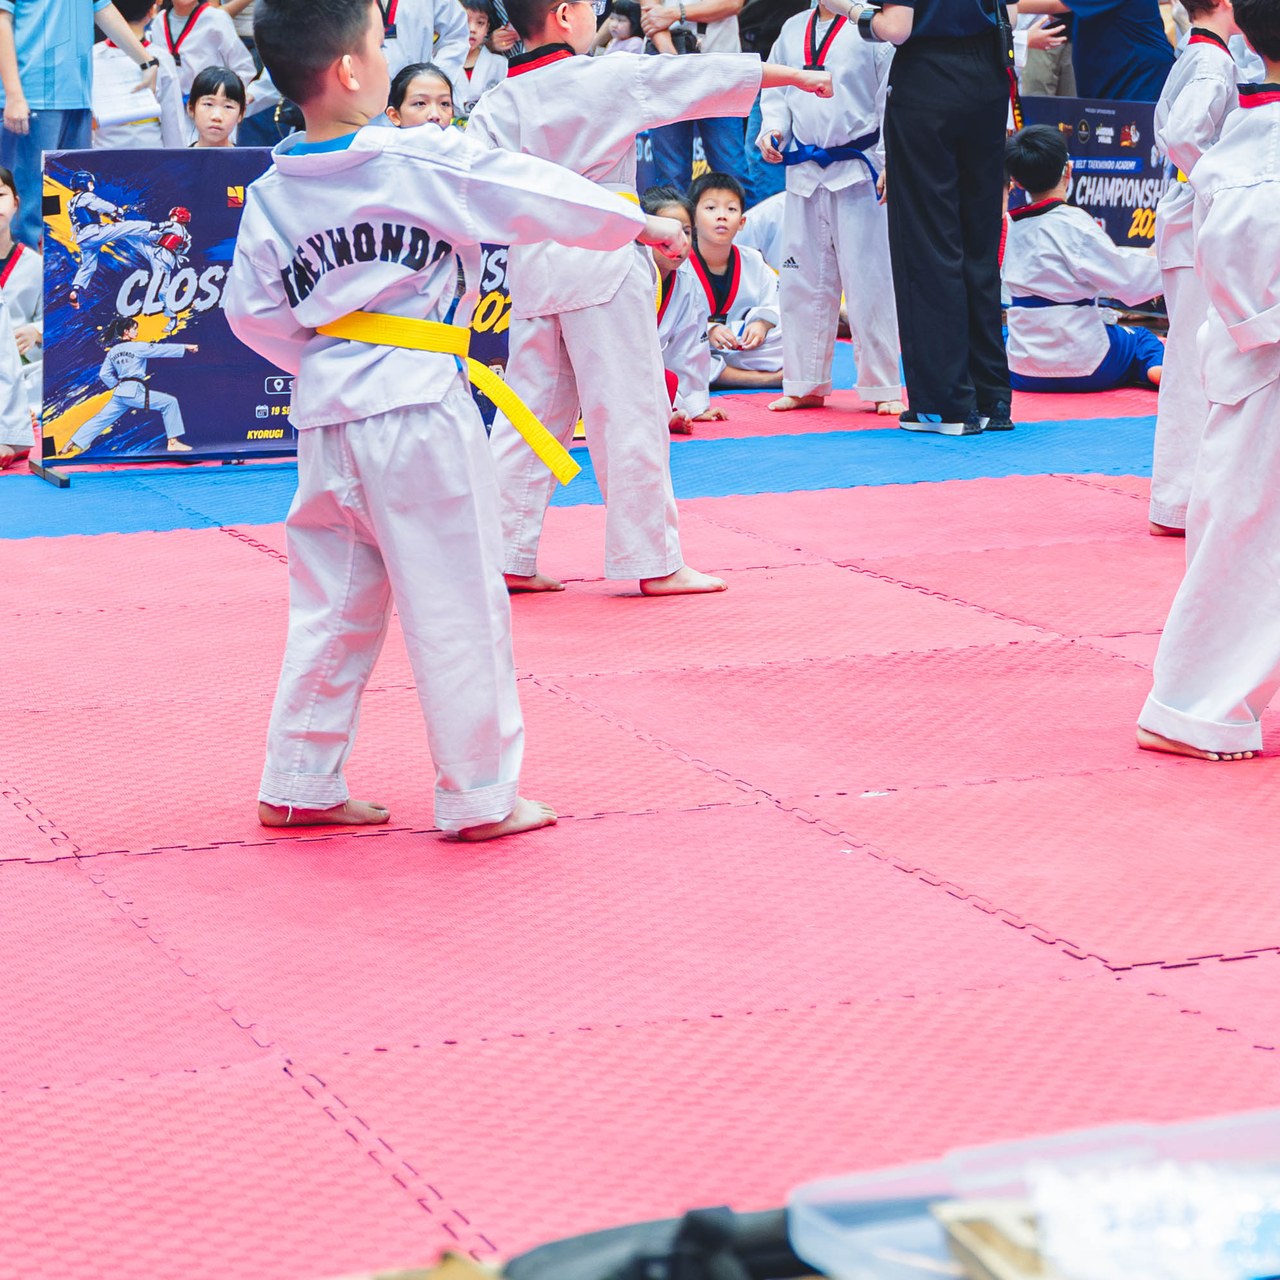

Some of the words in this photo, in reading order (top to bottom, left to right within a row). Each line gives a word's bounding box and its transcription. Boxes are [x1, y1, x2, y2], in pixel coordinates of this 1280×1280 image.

[116, 265, 236, 318] CLOS
[271, 406, 280, 416] 19
[246, 429, 284, 440] KYORUGI
